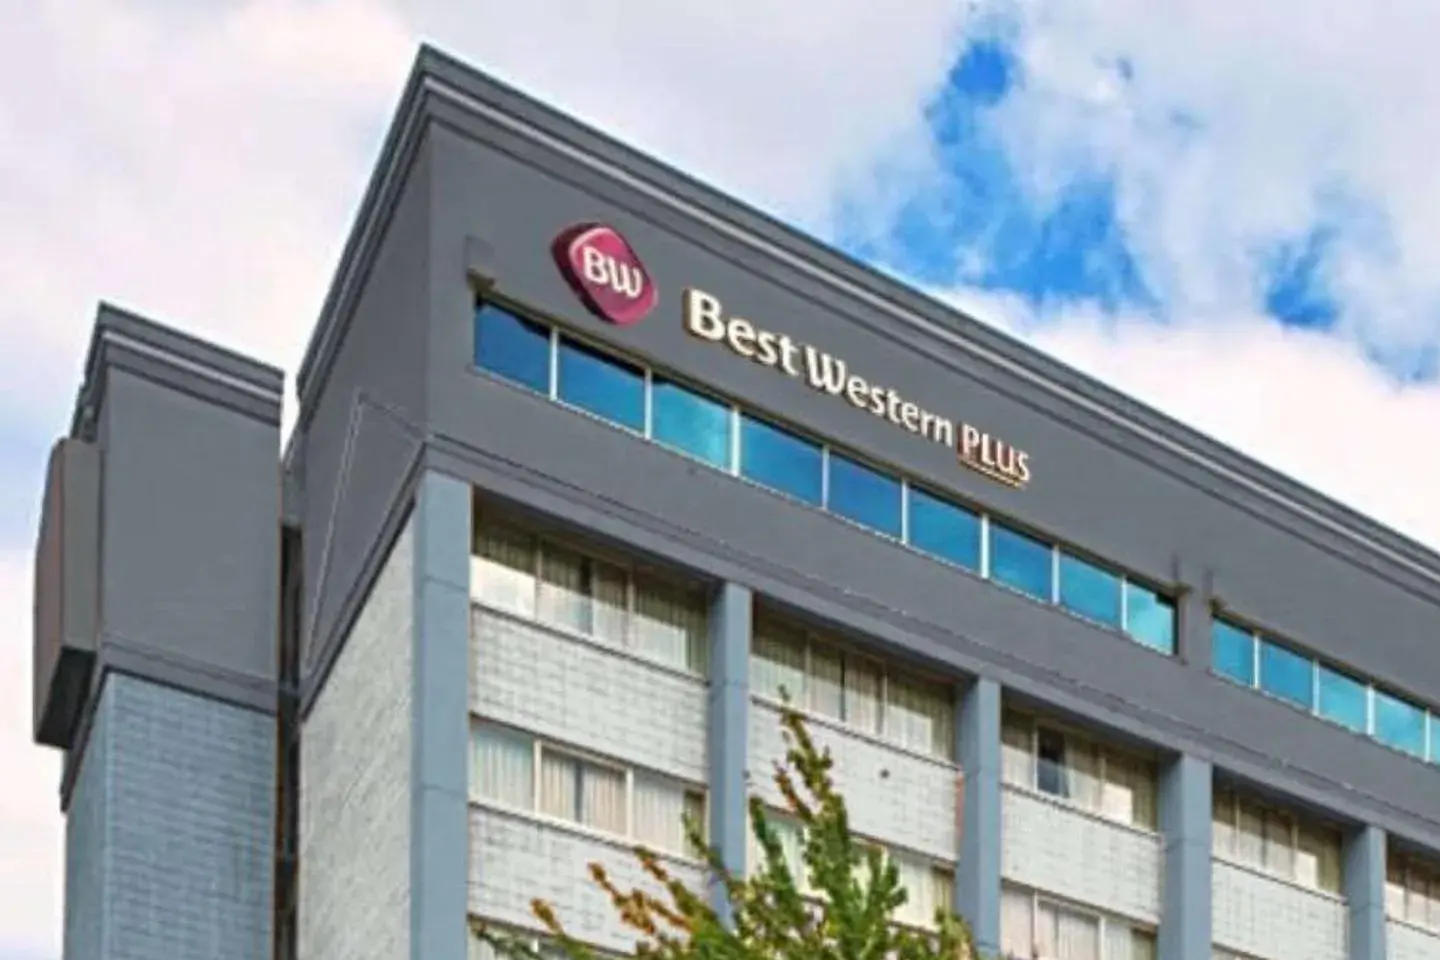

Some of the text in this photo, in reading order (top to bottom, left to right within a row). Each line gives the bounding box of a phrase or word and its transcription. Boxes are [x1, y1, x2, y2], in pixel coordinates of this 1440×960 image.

[583, 246, 643, 298] BW
[685, 289, 1031, 484] Best Western PLUS
